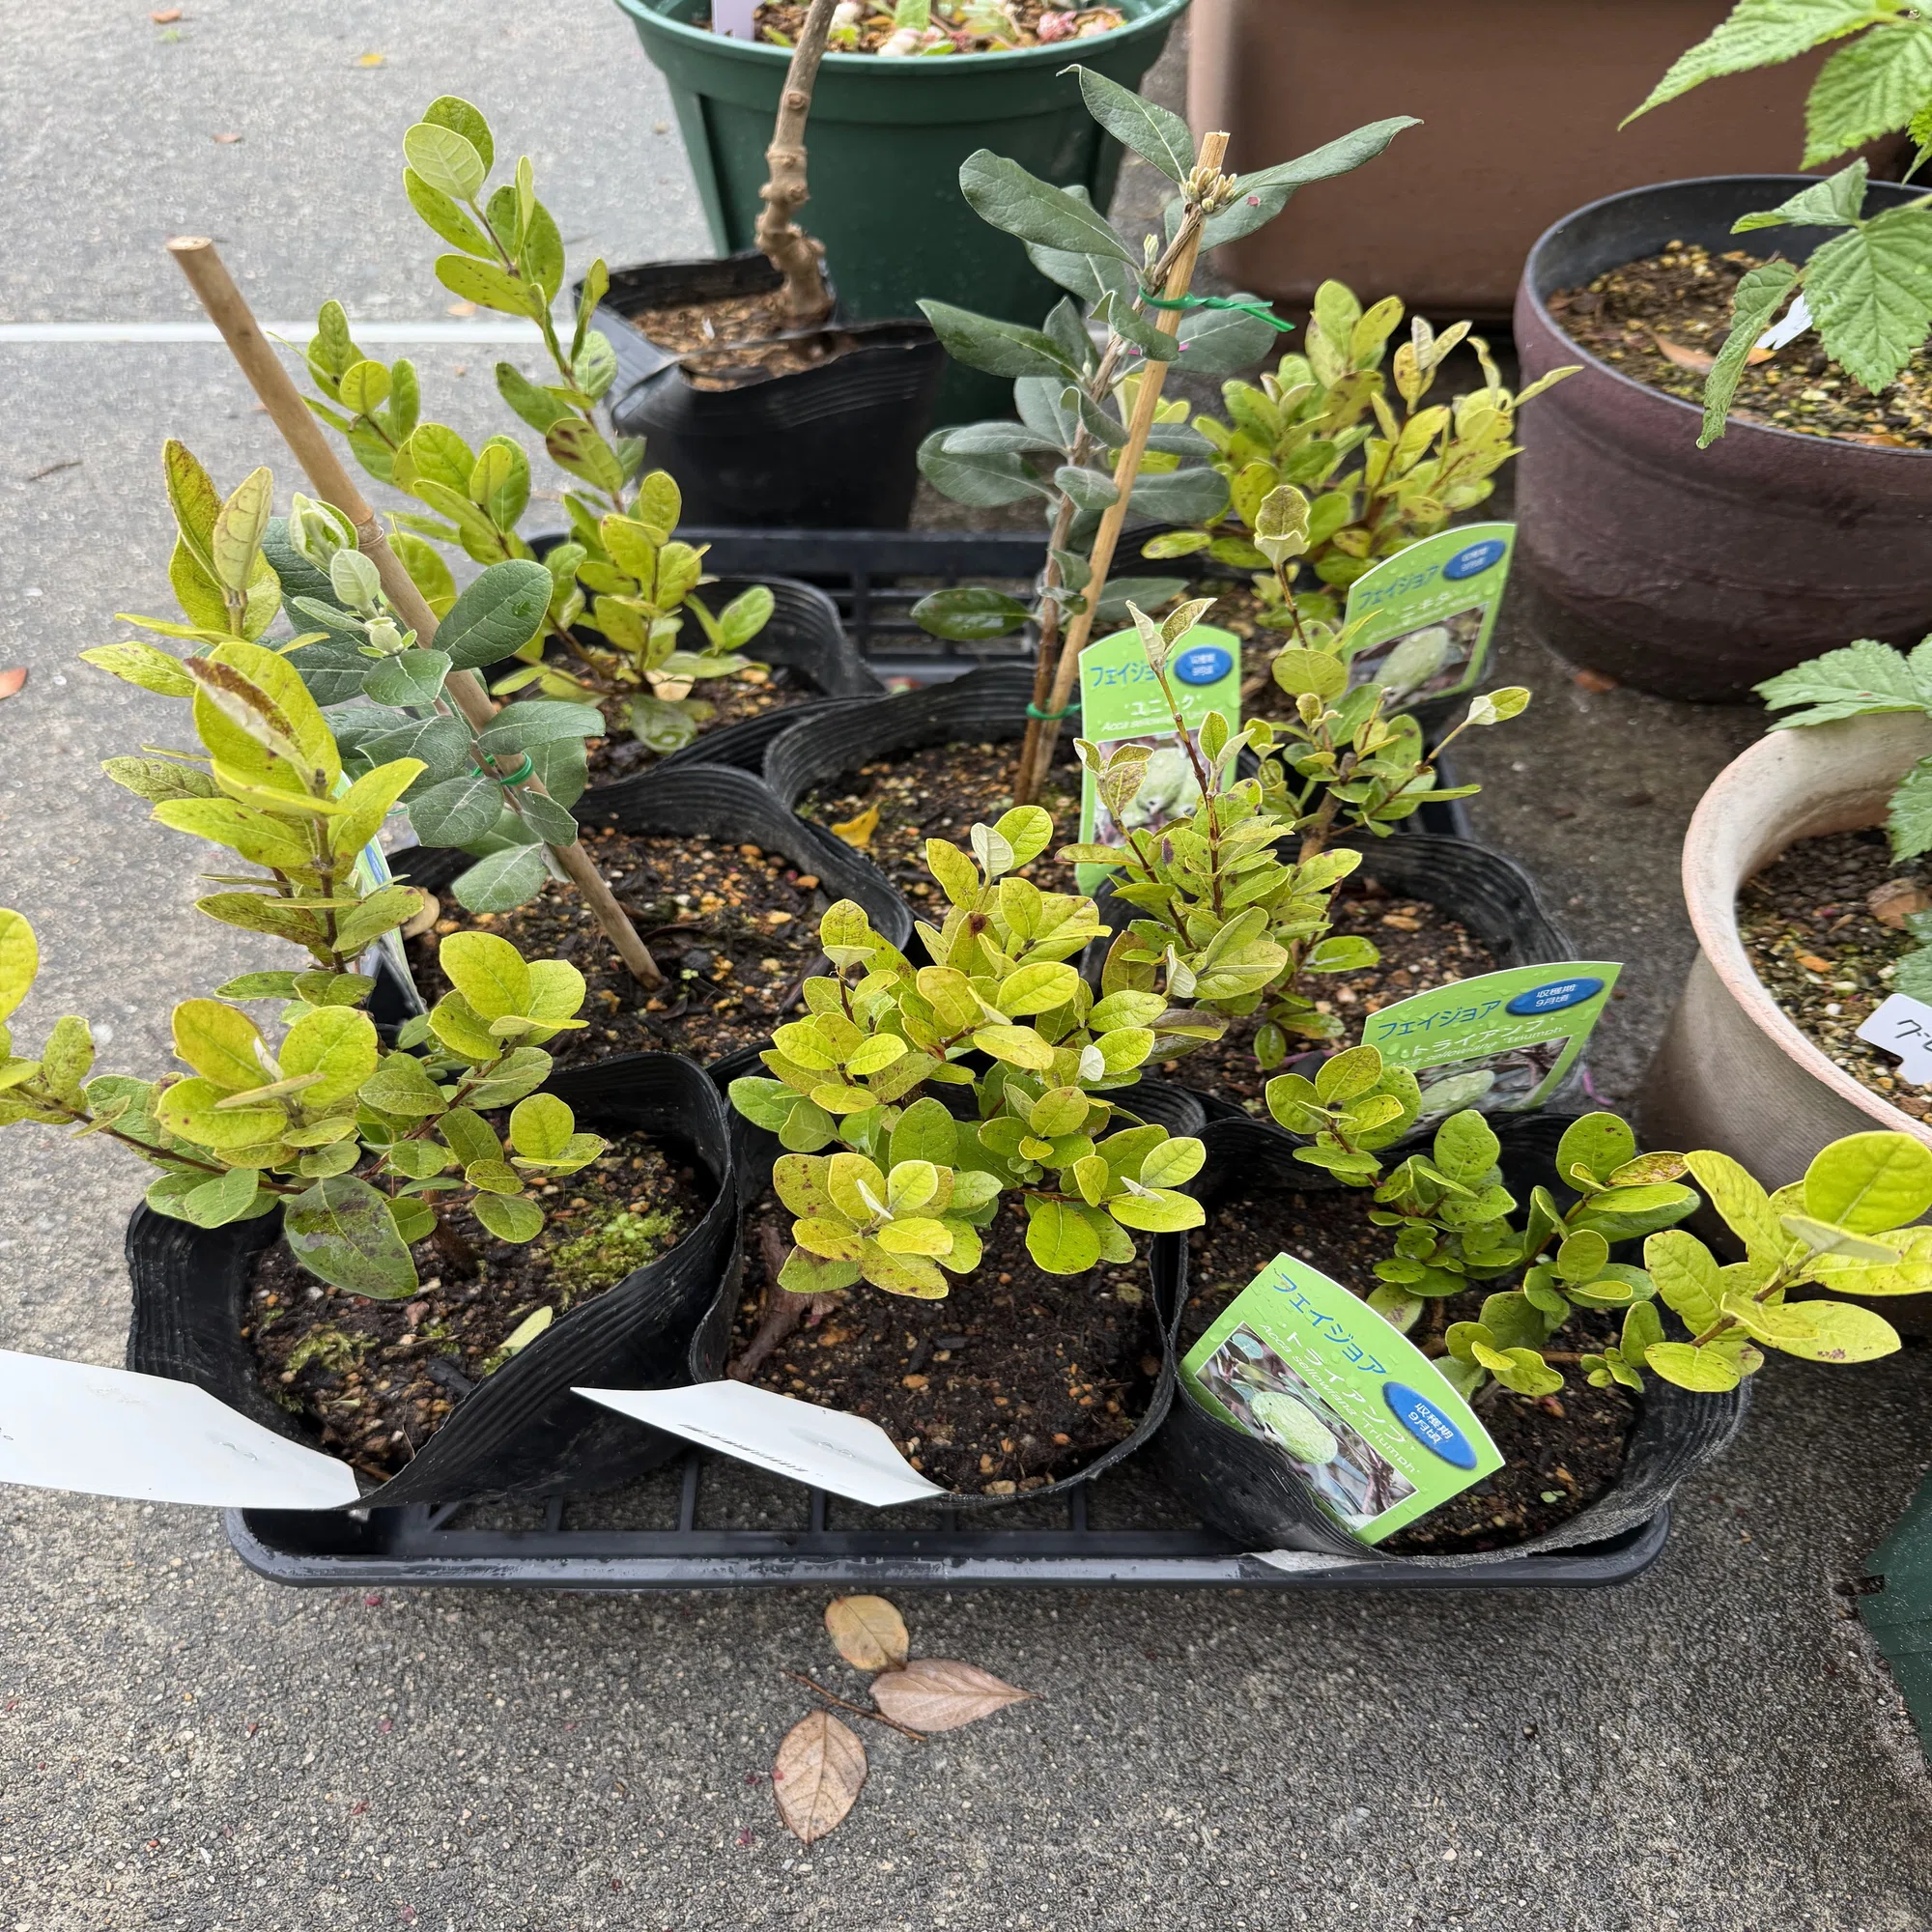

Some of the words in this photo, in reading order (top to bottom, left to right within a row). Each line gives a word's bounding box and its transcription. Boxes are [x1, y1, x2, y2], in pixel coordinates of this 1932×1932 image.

[1090, 661, 1169, 687] フェイジョ
[1378, 1000, 1502, 1040] フェイジョア
[1273, 1272, 1387, 1374] フェイジョア
[1259, 1324, 1292, 1352] Acca
[1293, 1355, 1357, 1416] sellowiana
[1408, 1411, 1443, 1443] 9月頃
[1414, 1403, 1454, 1439] 収穫期
